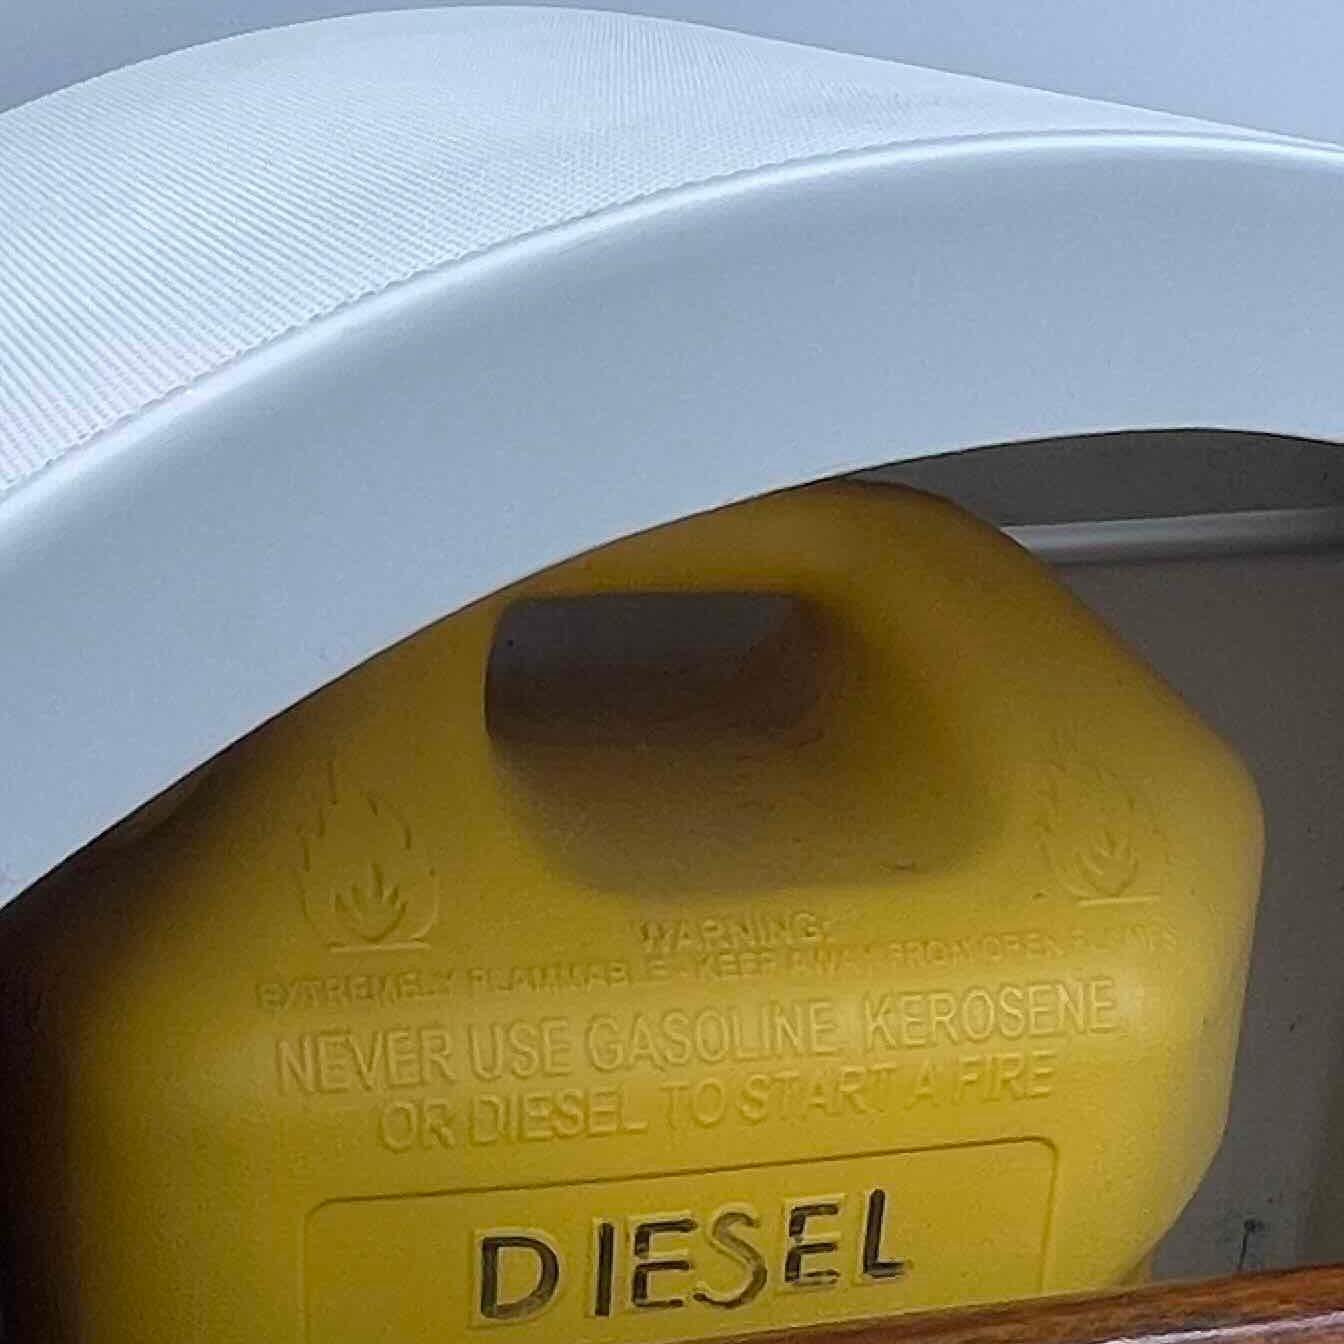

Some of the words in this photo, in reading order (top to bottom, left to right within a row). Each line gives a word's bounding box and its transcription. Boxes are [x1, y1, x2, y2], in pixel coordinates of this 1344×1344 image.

[692, 951, 778, 982] KEEP
[276, 1022, 457, 1094] NEVER
[467, 1015, 574, 1081] USE
[379, 1099, 455, 1154] OR
[468, 1083, 649, 1147] DIESEL
[659, 1076, 727, 1130] TO
[736, 1062, 897, 1125] START
[903, 1057, 940, 1111] A
[956, 1049, 1057, 1102] FIRE
[476, 1187, 912, 1322] DIESEL
